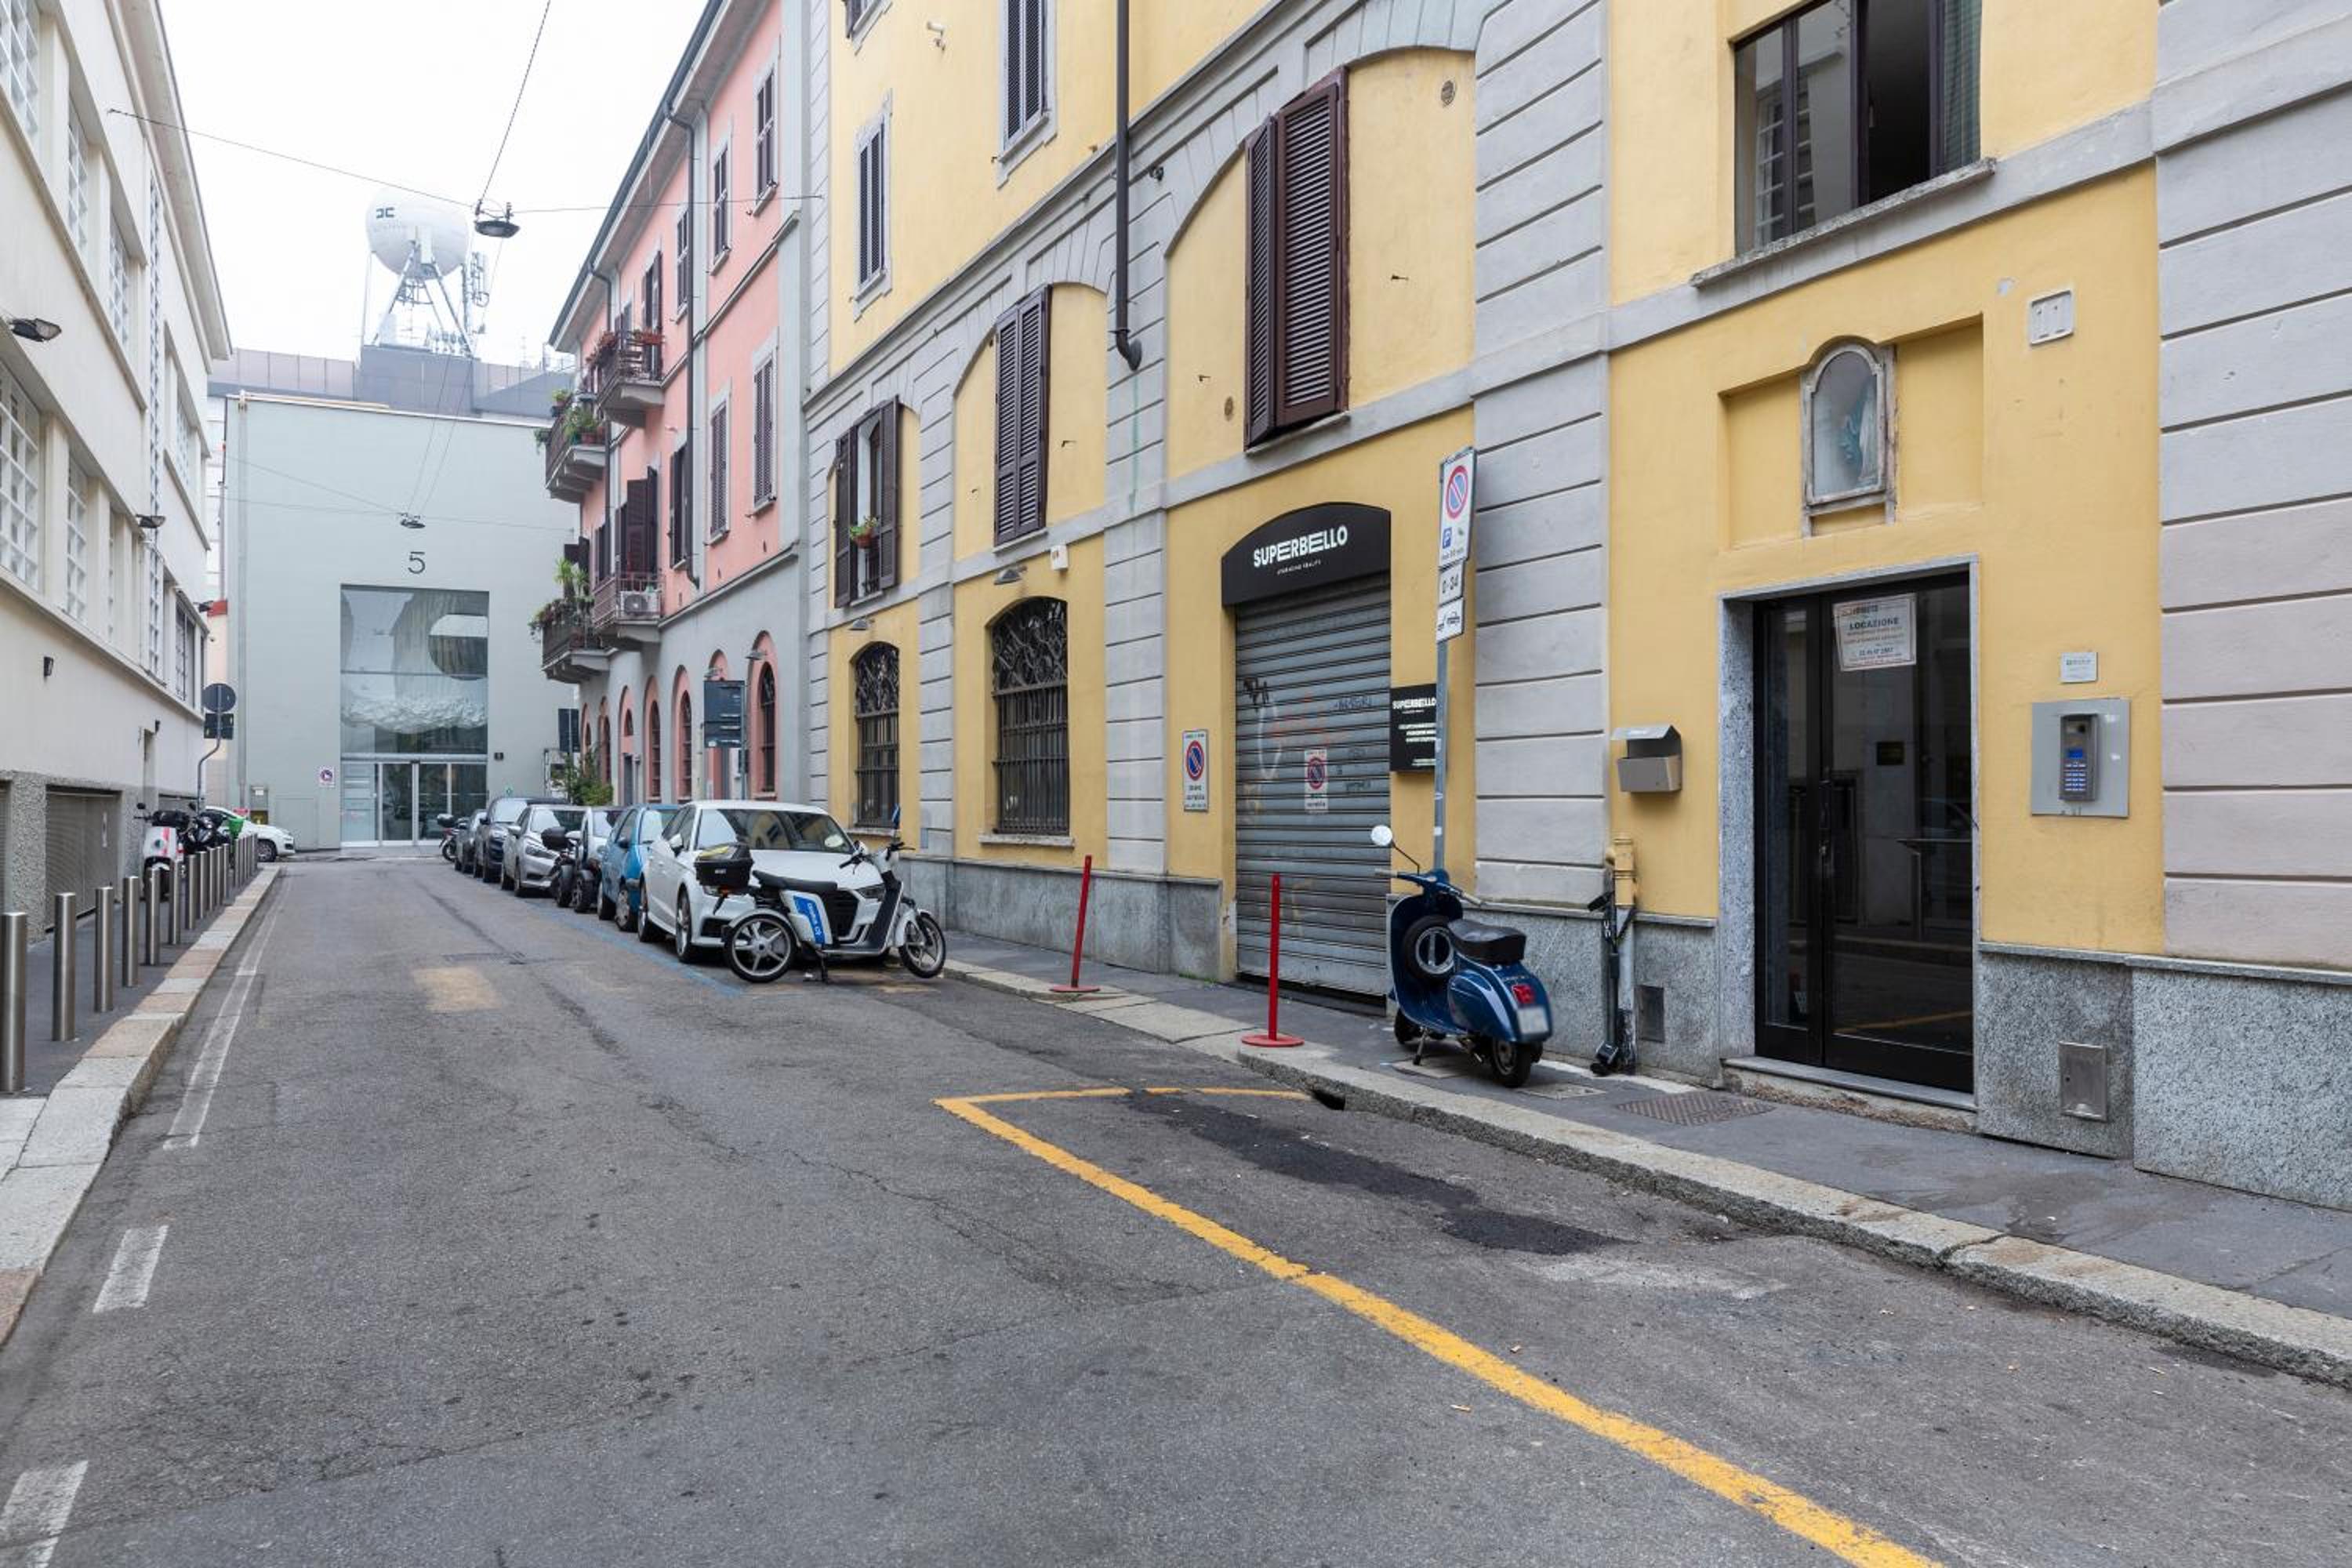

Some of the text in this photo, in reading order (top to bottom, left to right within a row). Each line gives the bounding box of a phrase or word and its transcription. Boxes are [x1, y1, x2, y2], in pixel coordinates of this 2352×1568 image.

[1254, 524, 1348, 568] SUPERBELLO
[408, 551, 426, 575] 5
[1849, 617, 1900, 630] LOCAZIONE
[1392, 697, 1436, 710] SUPERBELLO
